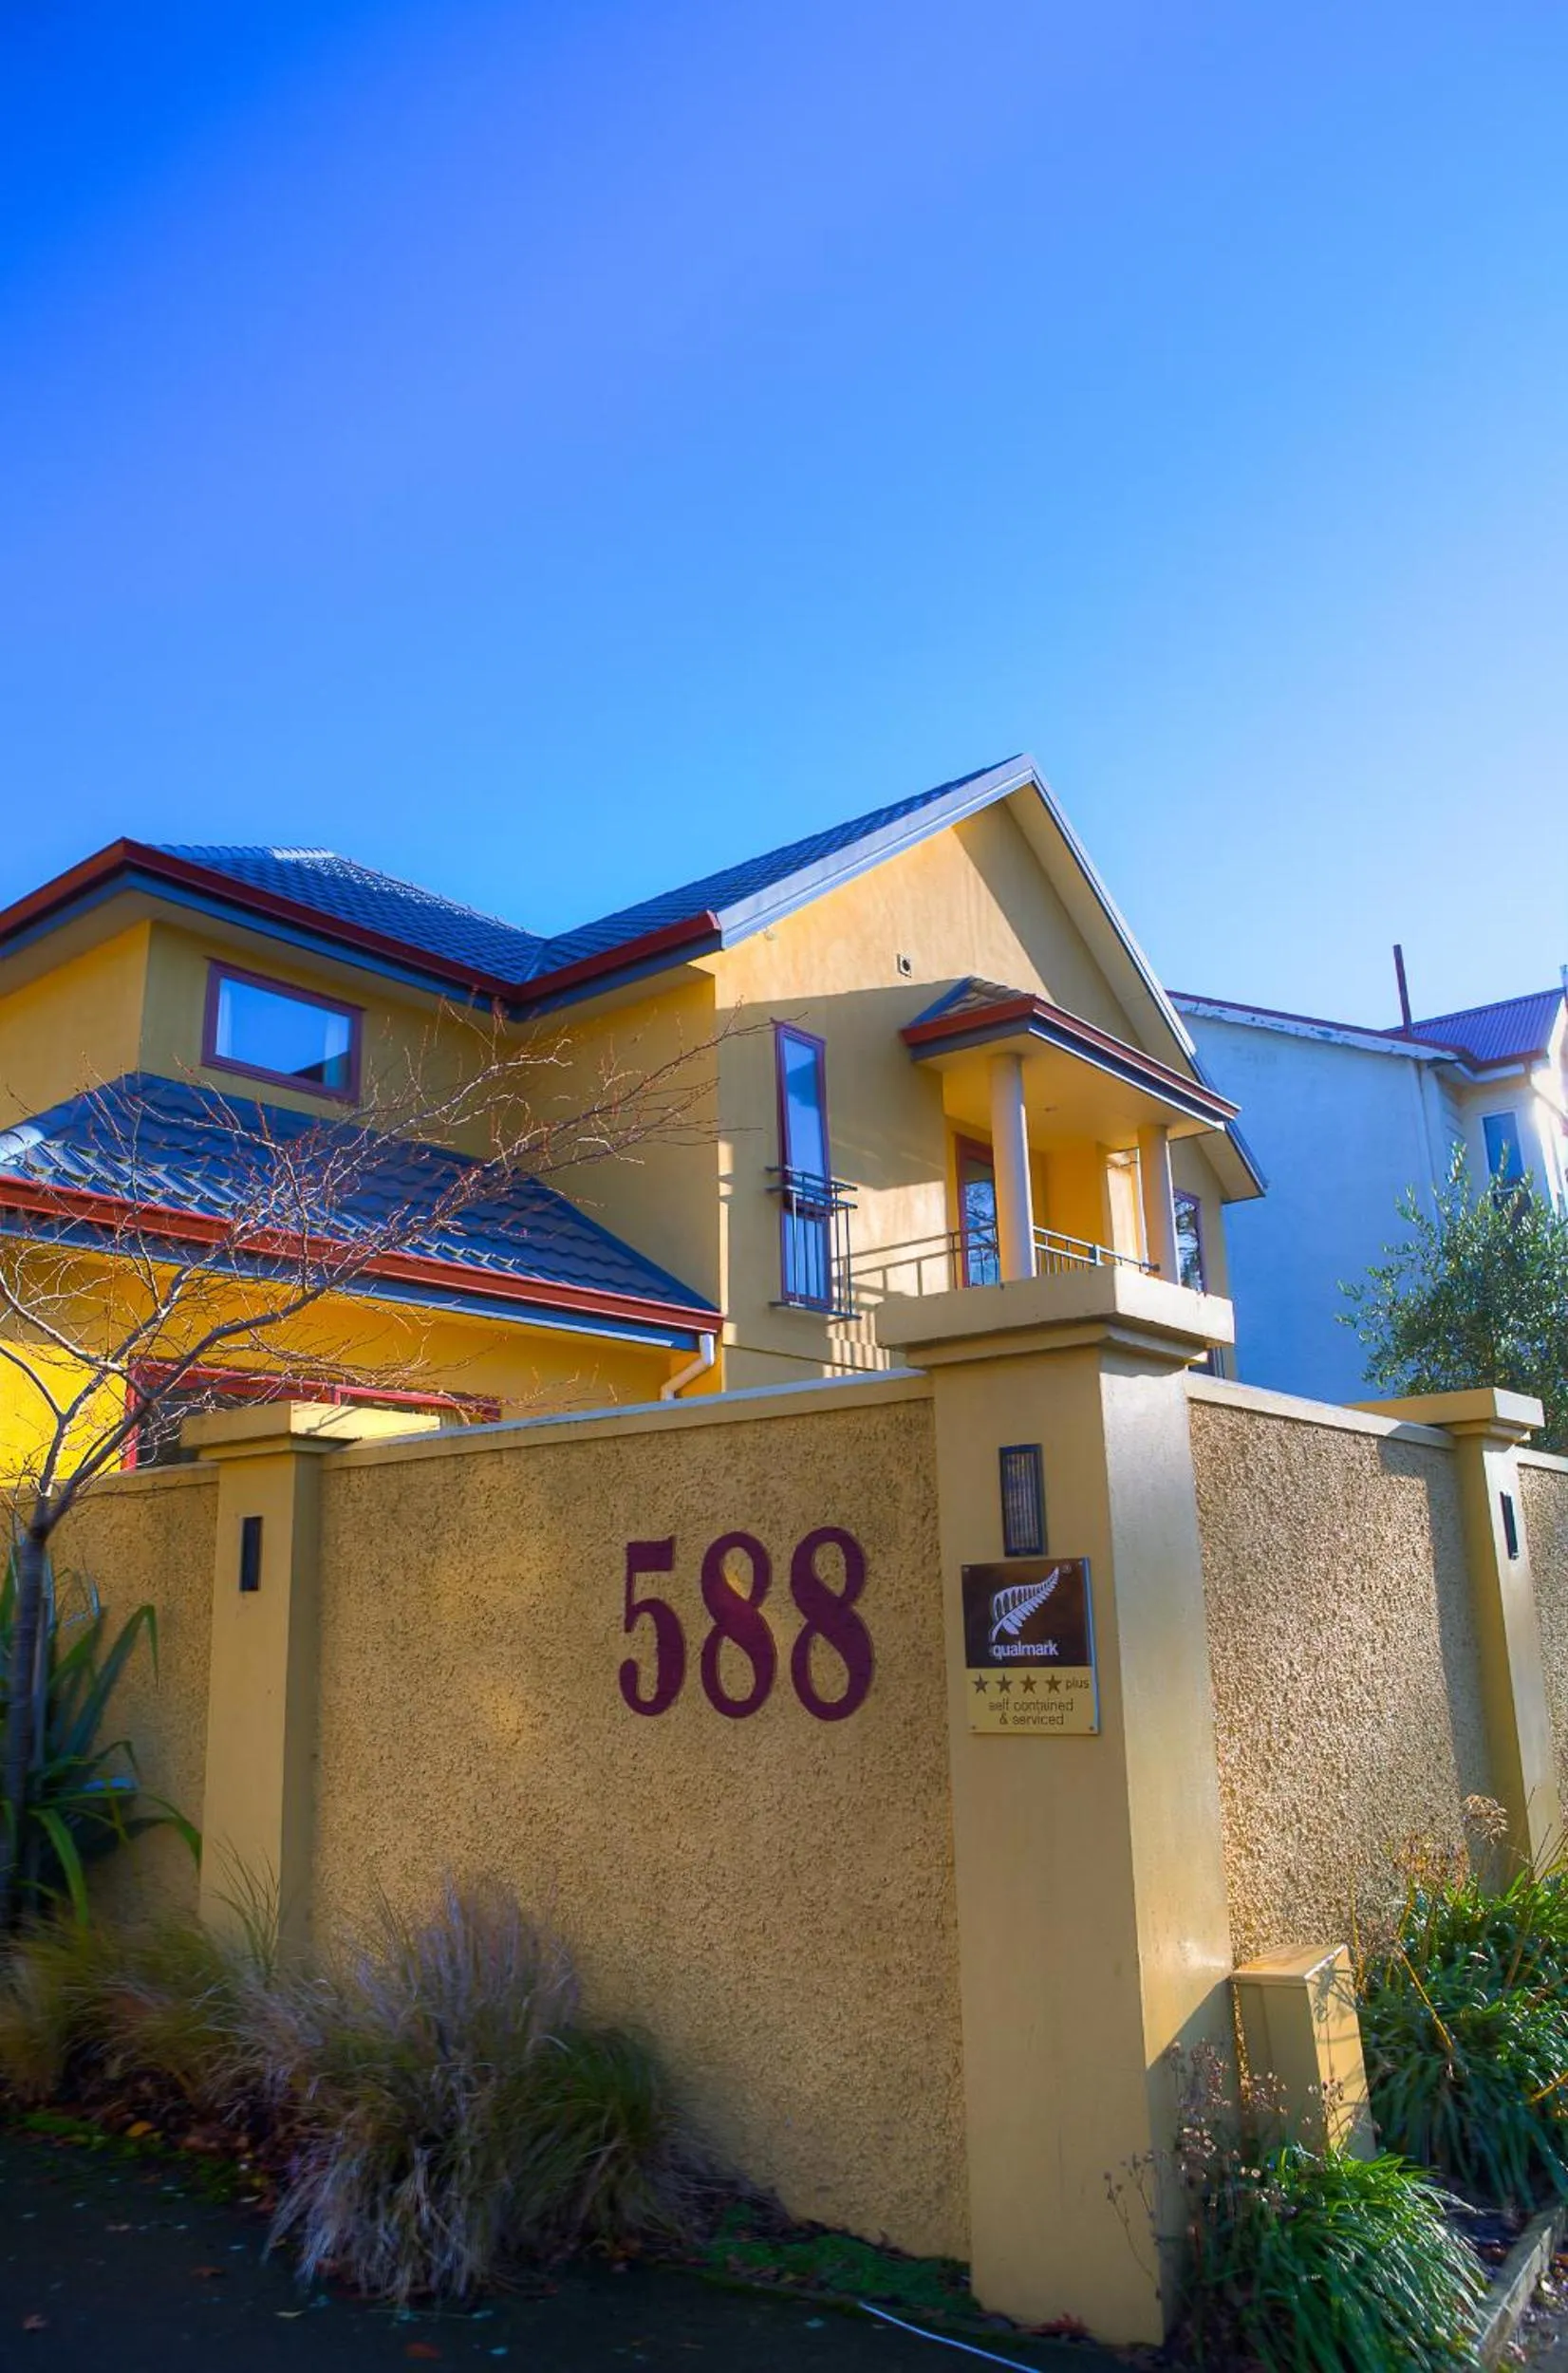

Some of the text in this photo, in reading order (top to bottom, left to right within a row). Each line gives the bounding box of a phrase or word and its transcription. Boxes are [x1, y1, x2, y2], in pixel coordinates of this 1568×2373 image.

[619, 1526, 874, 1721] 588
[993, 1639, 1058, 1659] qualmark
[1065, 1676, 1090, 1691] plus
[988, 1697, 1073, 1711] self contained
[999, 1712, 1064, 1726] & serviced
